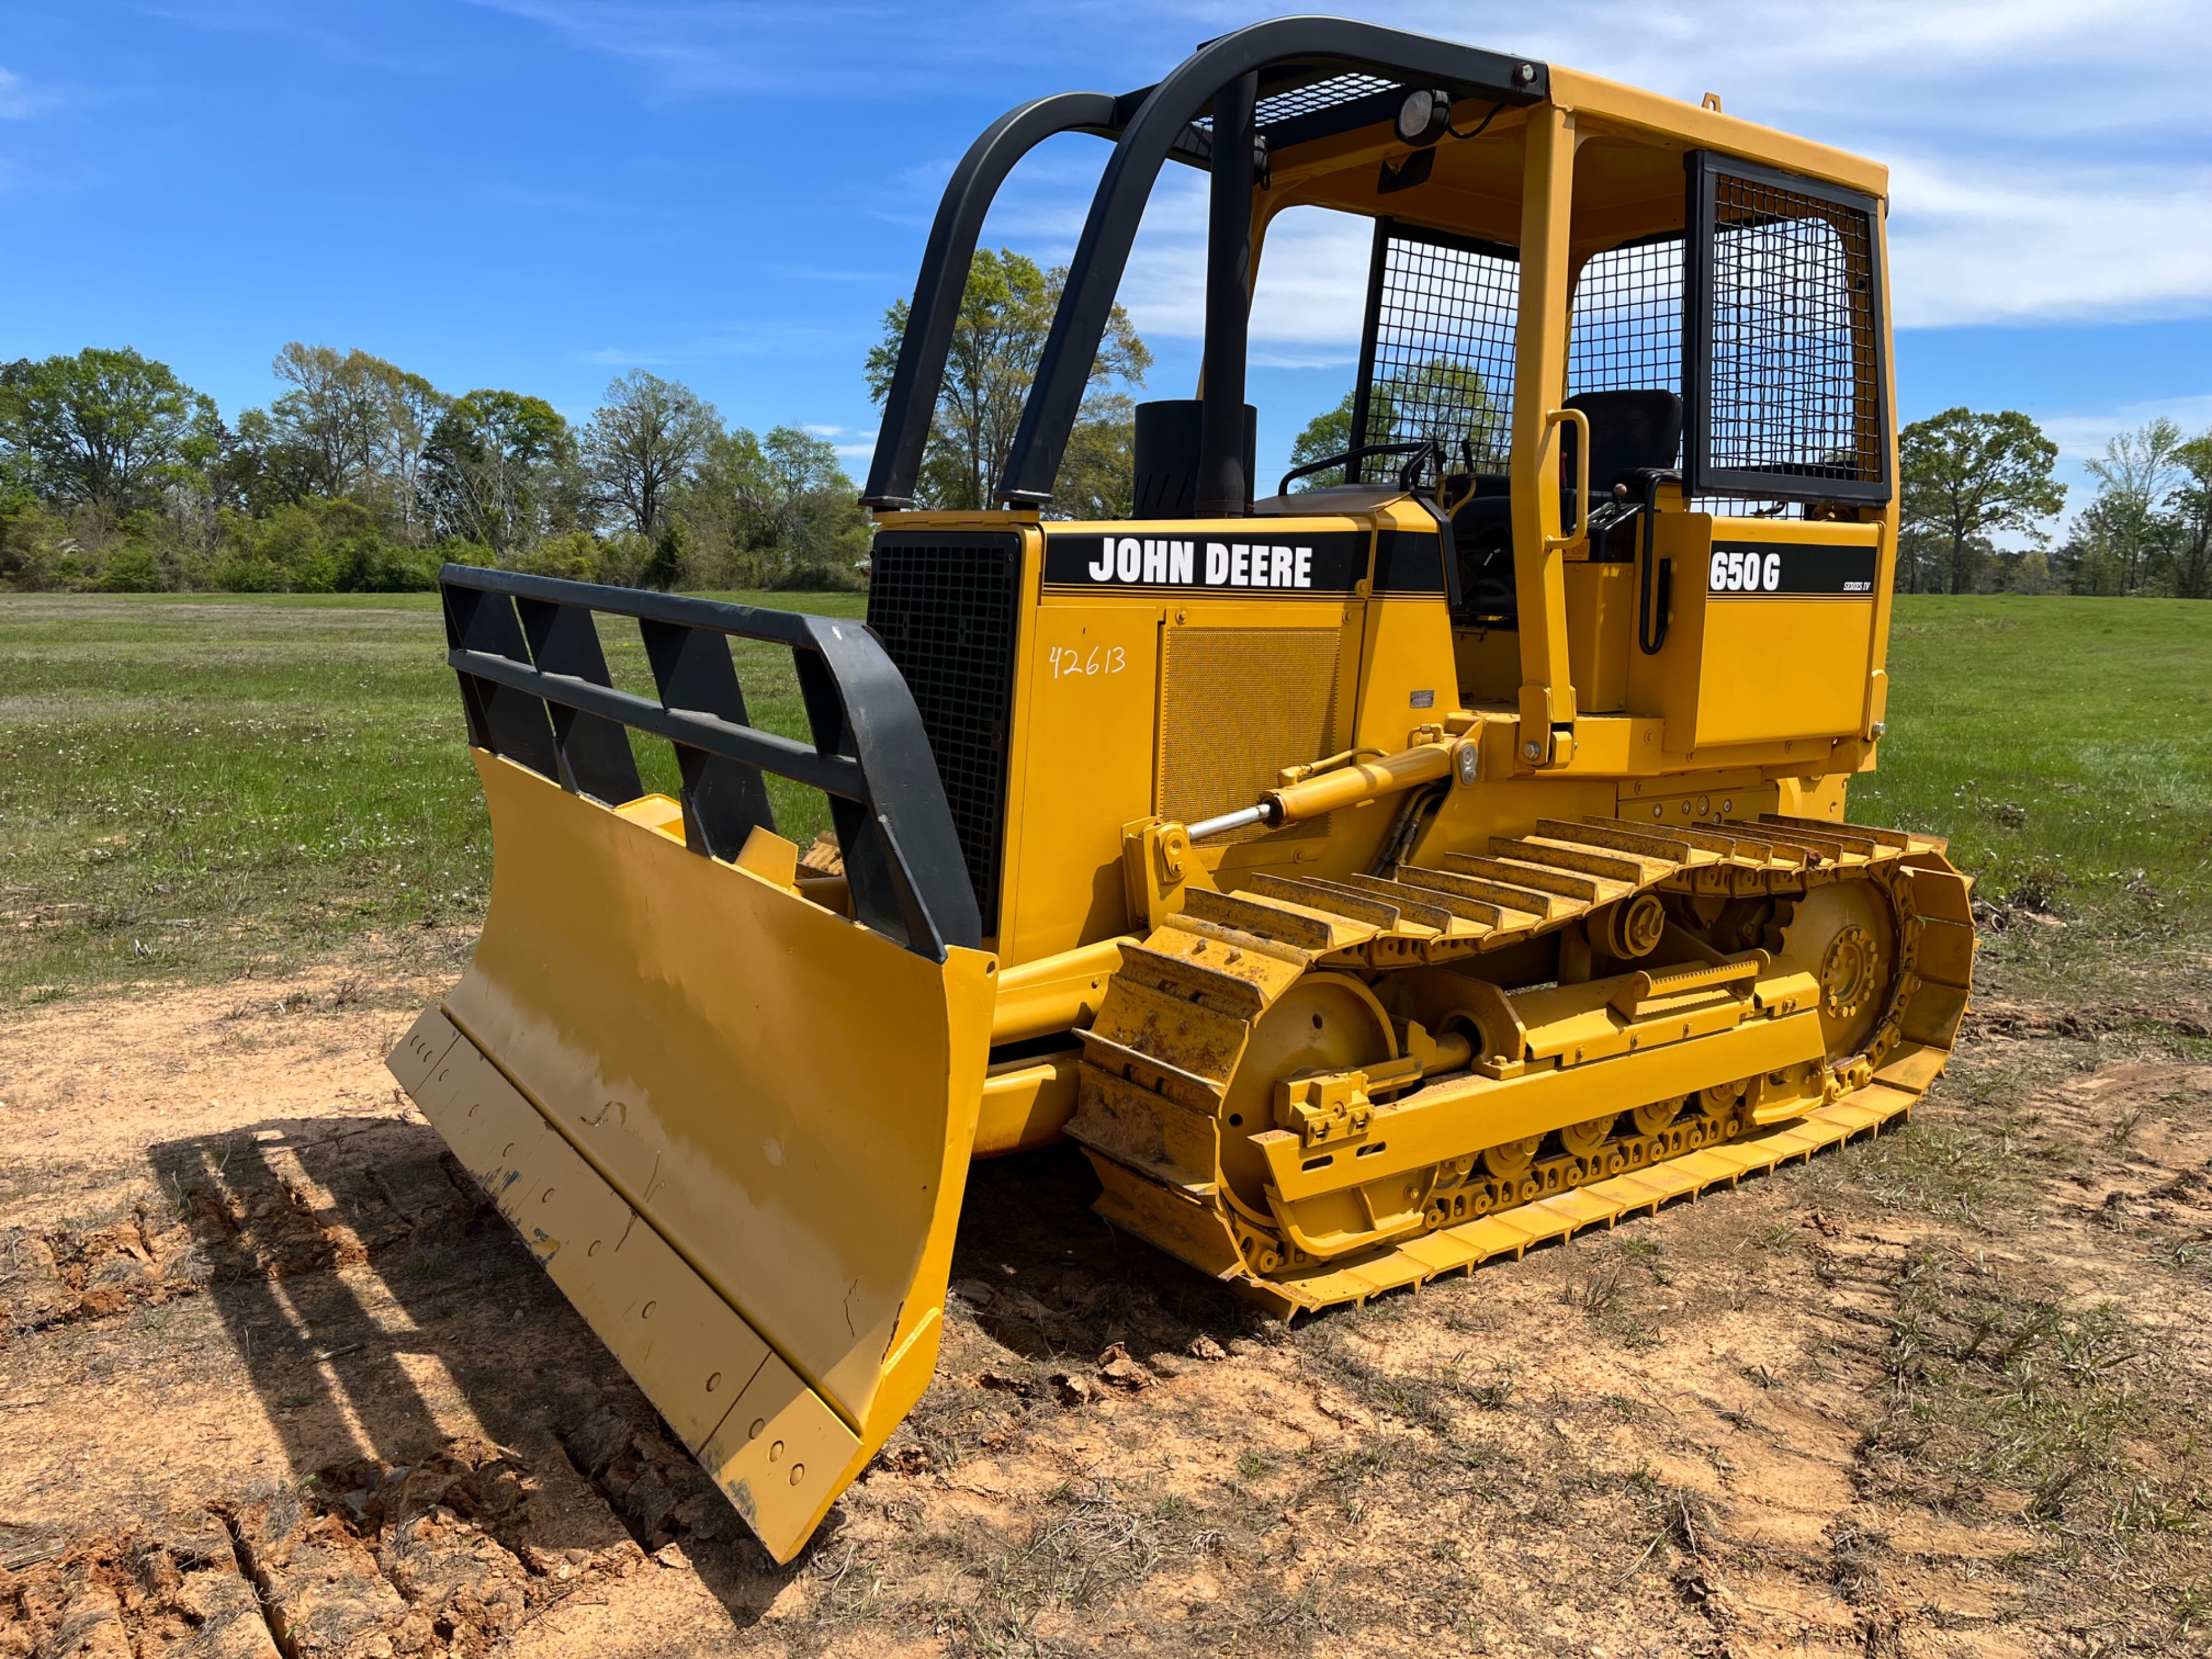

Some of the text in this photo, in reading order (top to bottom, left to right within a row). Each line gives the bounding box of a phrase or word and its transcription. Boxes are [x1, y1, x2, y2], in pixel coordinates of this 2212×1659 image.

[1089, 537, 1312, 588] JOHN DEERE
[1049, 646, 1126, 679] 42613
